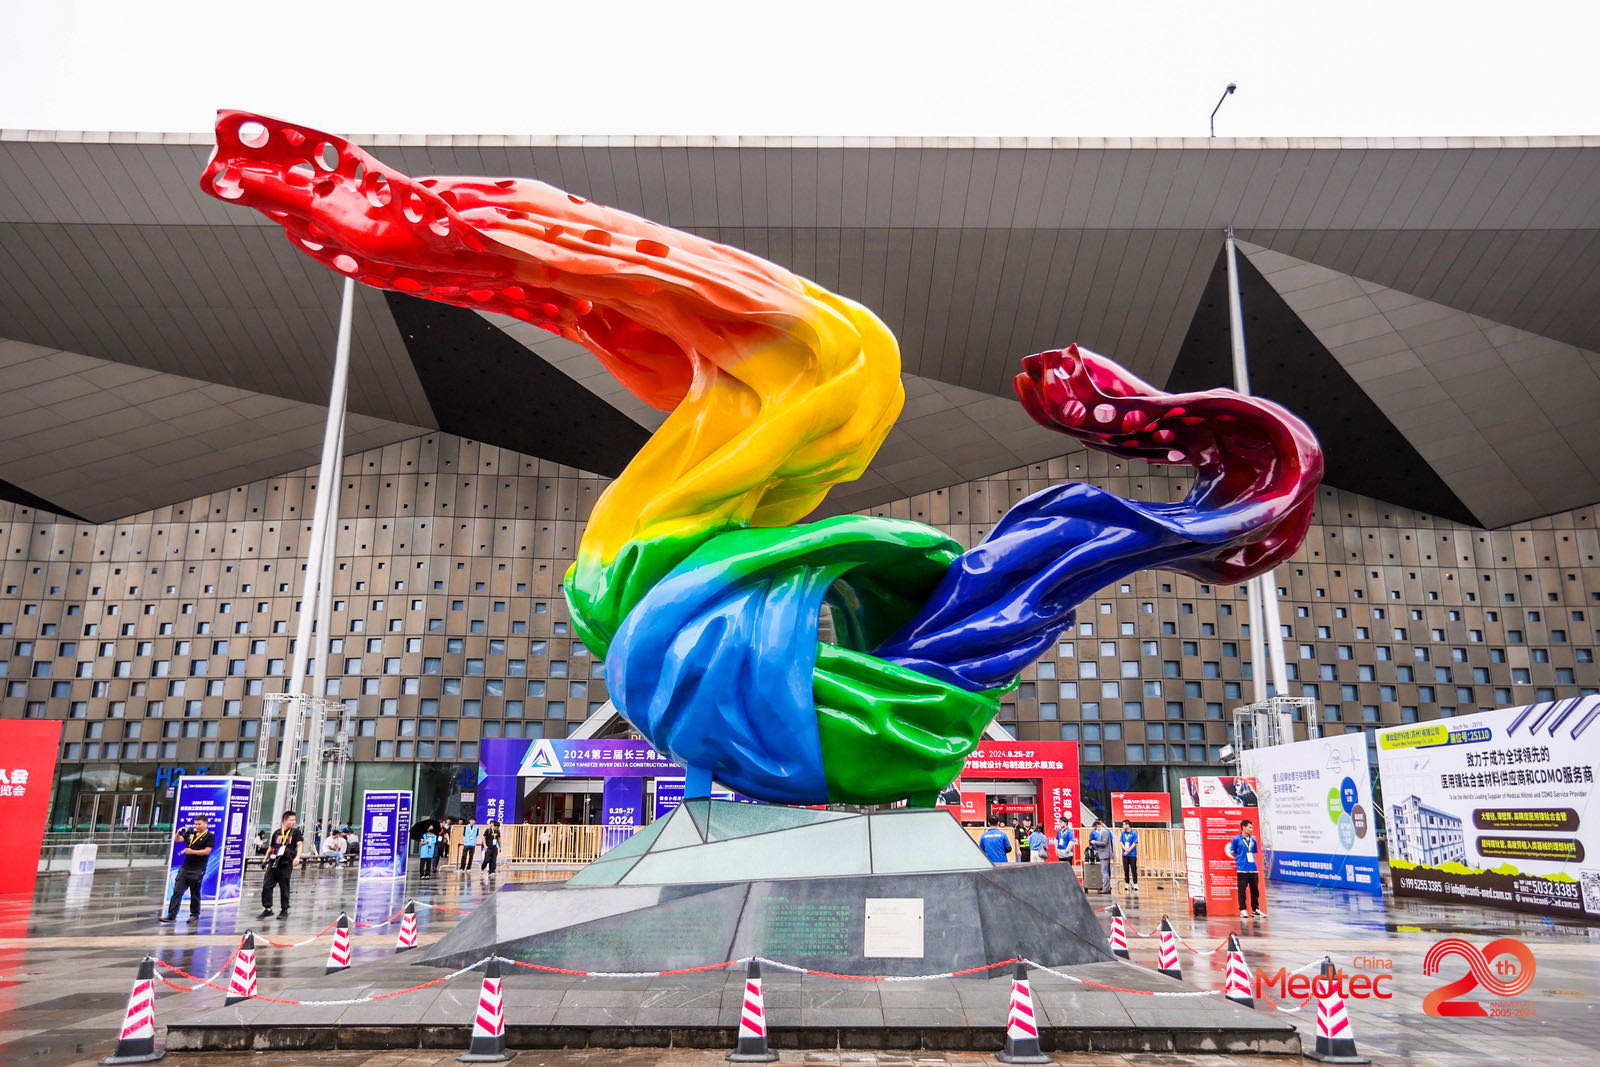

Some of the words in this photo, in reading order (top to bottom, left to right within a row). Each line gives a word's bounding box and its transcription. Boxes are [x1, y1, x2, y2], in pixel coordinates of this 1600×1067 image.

[1466, 746, 1550, 767] 致力于成为全球领先的
[1441, 766, 1594, 789] 医用镍钛合金材料供应商和CDMO服务商
[1053, 788, 1061, 830] WELCOME
[608, 815, 634, 825] 2024
[1532, 880, 1554, 895] 5032
[1555, 882, 1579, 898] 3385
